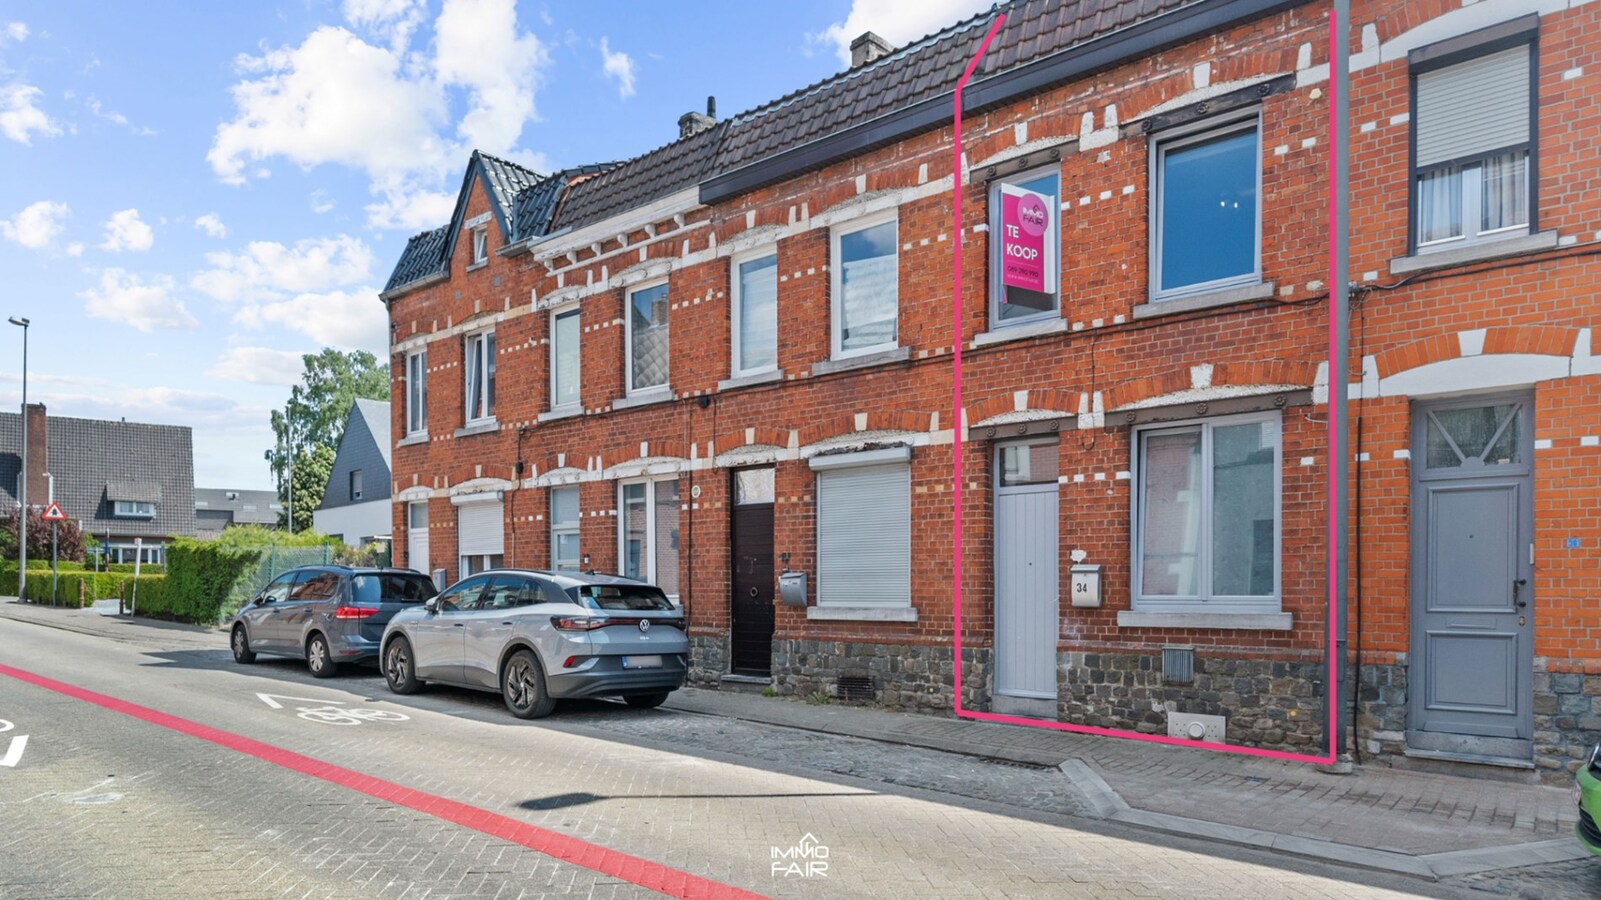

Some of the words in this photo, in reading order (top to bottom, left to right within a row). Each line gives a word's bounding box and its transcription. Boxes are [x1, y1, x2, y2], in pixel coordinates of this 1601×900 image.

[1022, 206, 1044, 219] IMMO
[1023, 214, 1043, 227] FAIR
[1006, 224, 1019, 238] TE
[1006, 243, 1038, 260] KOOP
[1076, 582, 1087, 593] 34
